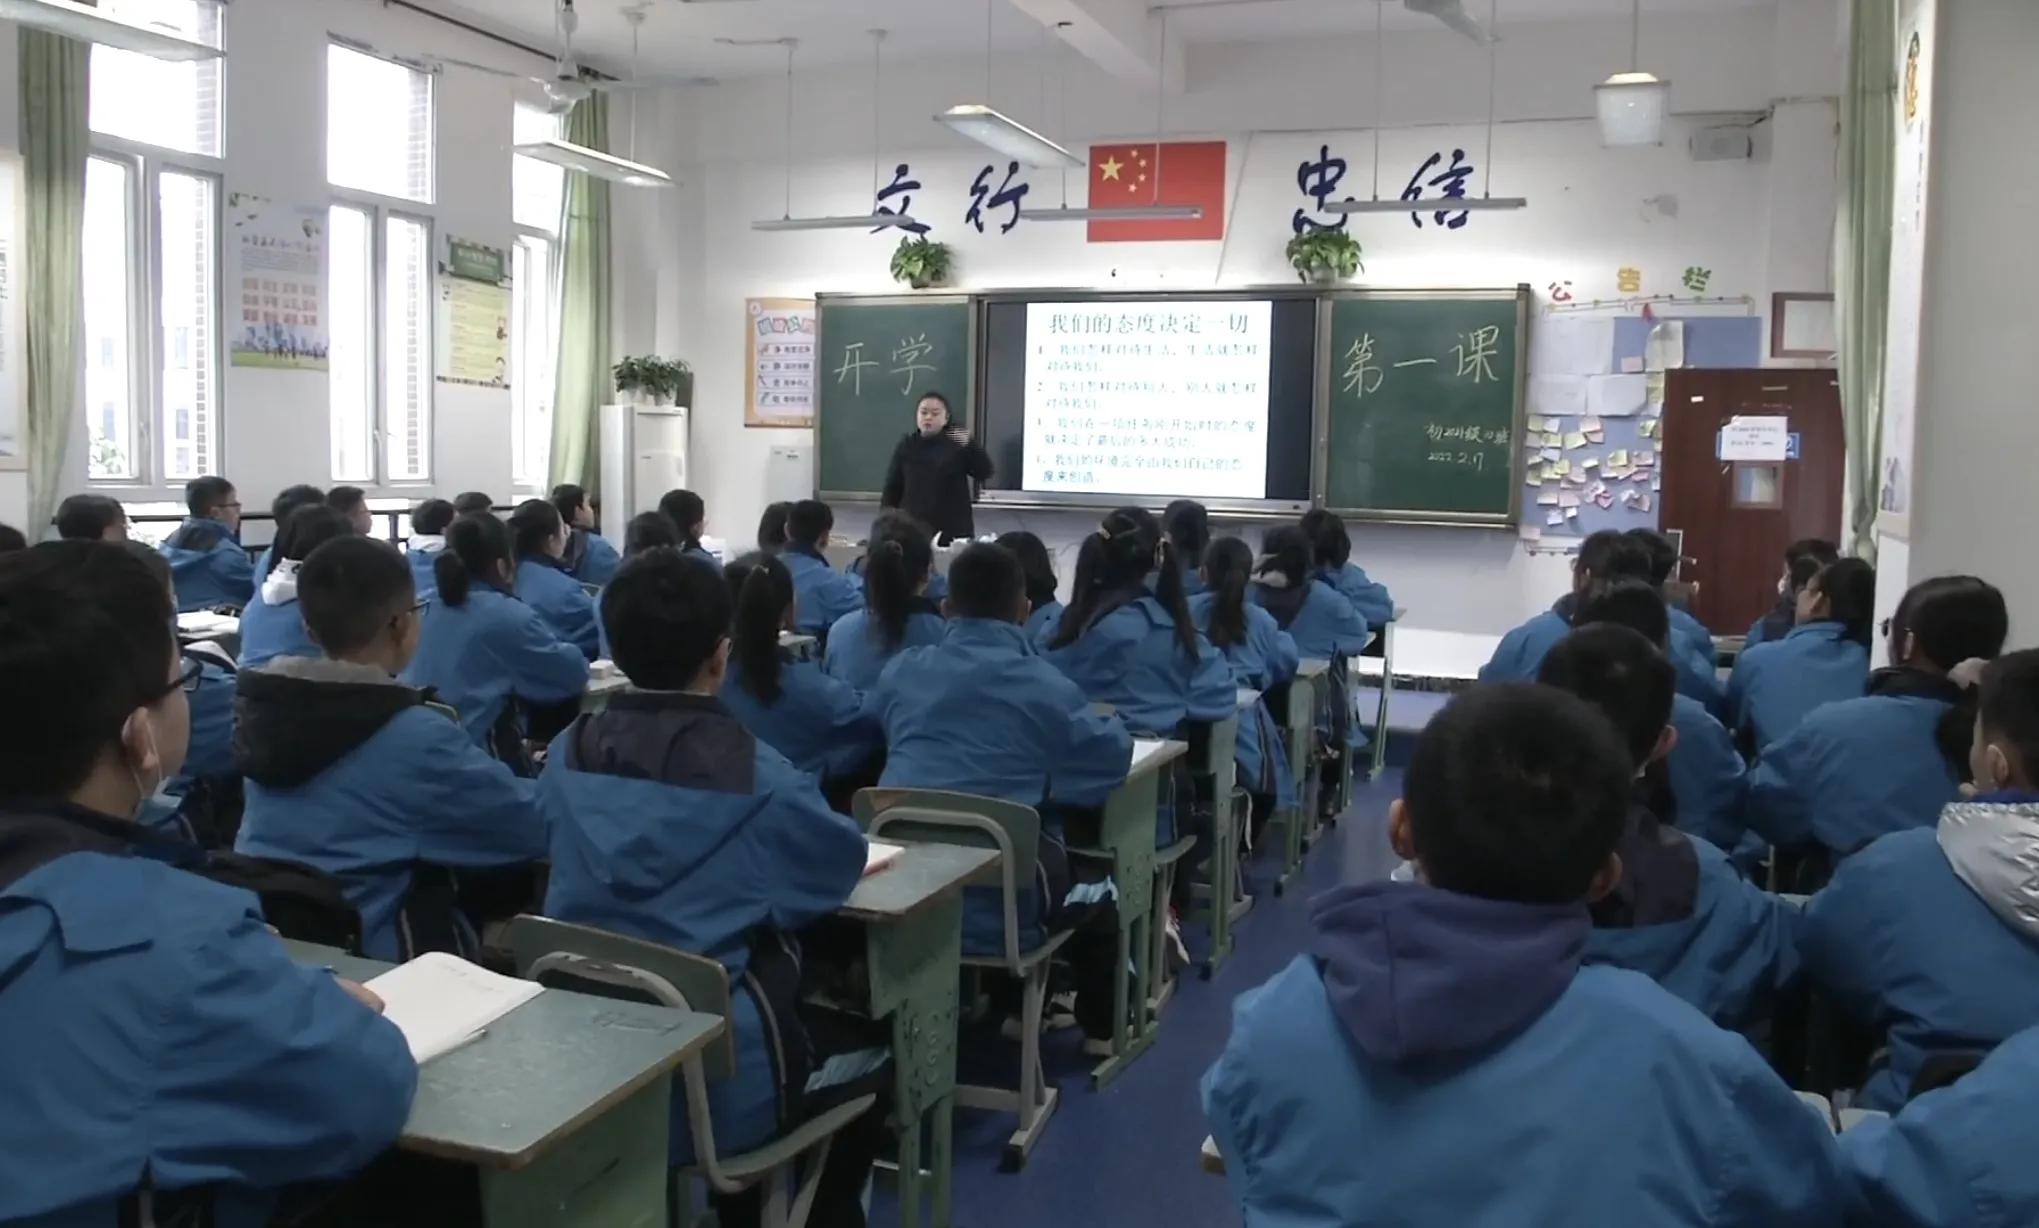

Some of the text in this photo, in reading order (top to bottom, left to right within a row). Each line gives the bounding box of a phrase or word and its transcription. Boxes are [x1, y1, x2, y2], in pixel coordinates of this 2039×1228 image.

[1548, 266, 1712, 303] 公告栏
[1049, 312, 1249, 336] 我们的态度决定一切
[832, 332, 938, 397] 开学
[1342, 324, 1501, 399] 第一课
